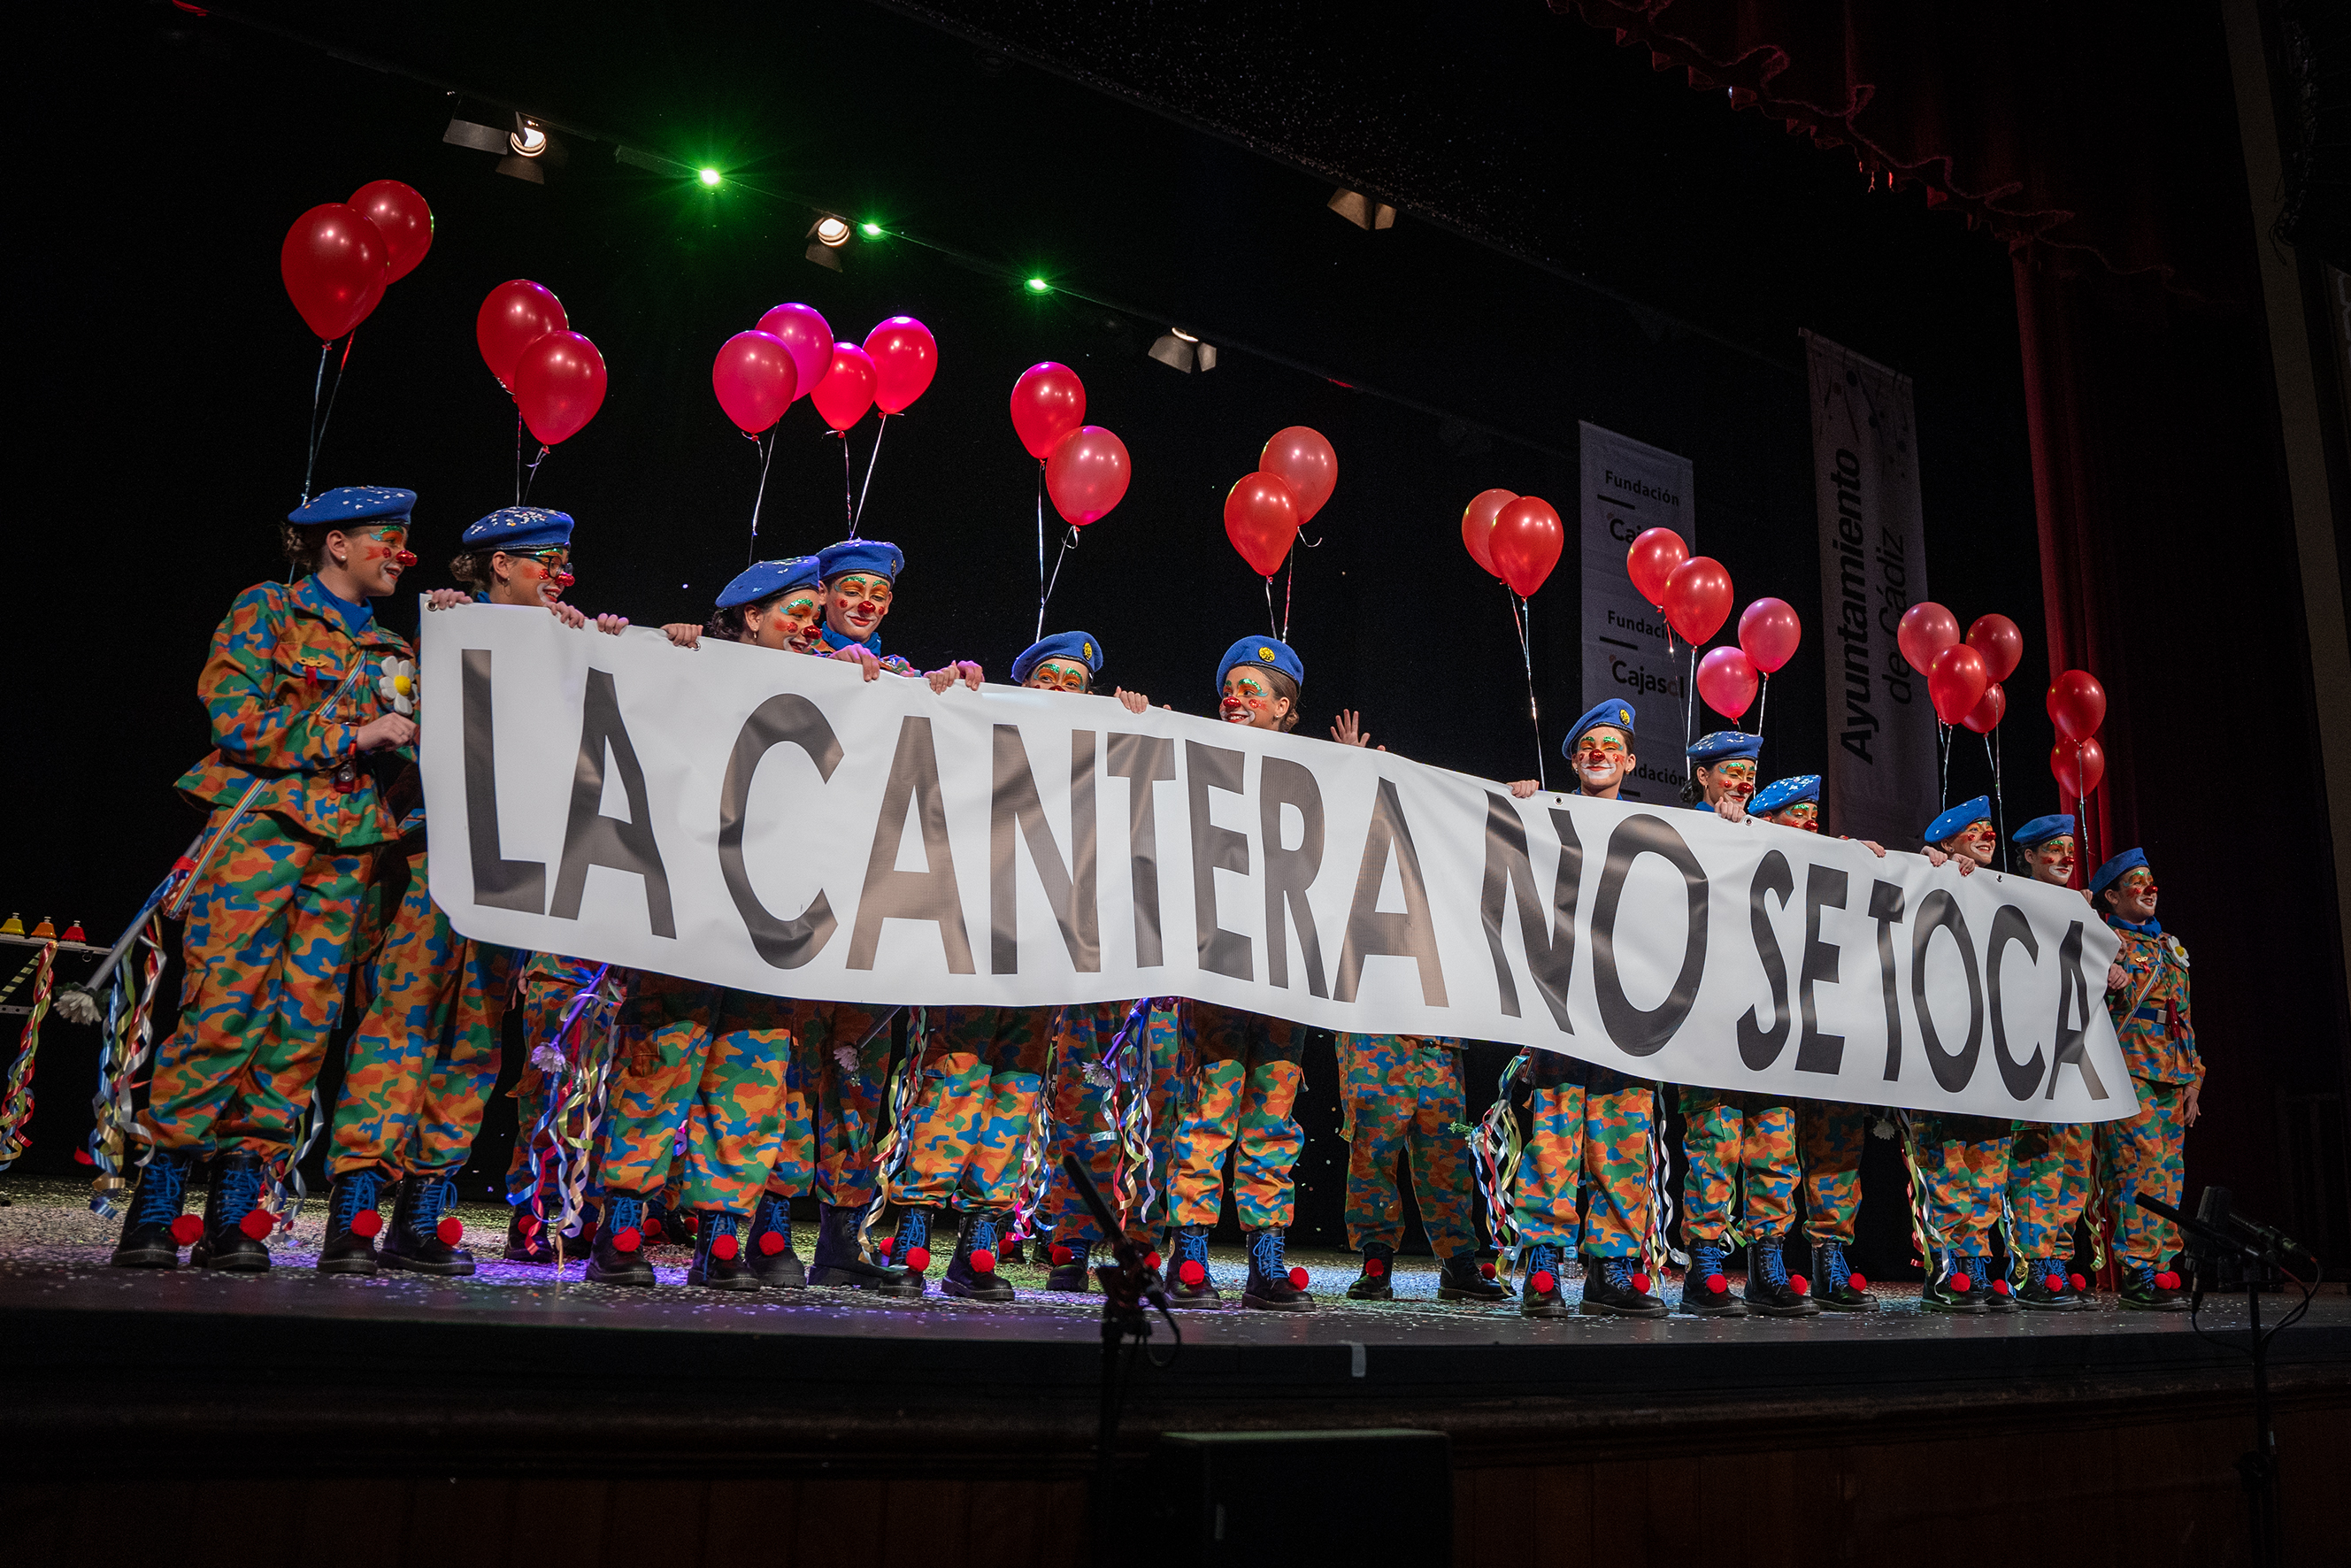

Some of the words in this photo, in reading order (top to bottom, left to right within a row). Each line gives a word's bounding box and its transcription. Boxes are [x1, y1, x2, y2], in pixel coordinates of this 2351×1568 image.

[1606, 470, 1679, 506] Fundación
[1831, 449, 1879, 765] Ayuntamiento
[1877, 527, 1907, 639] Cádiz
[1608, 611, 1683, 644] Fundación
[1612, 660, 1684, 698] Cajasol
[1882, 651, 1912, 704] de
[462, 649, 677, 940] LA
[718, 693, 1449, 1008] CANTERA
[1480, 788, 1709, 1057] NO
[1737, 849, 1848, 1075] SE
[1868, 879, 2109, 1101] TOCA
